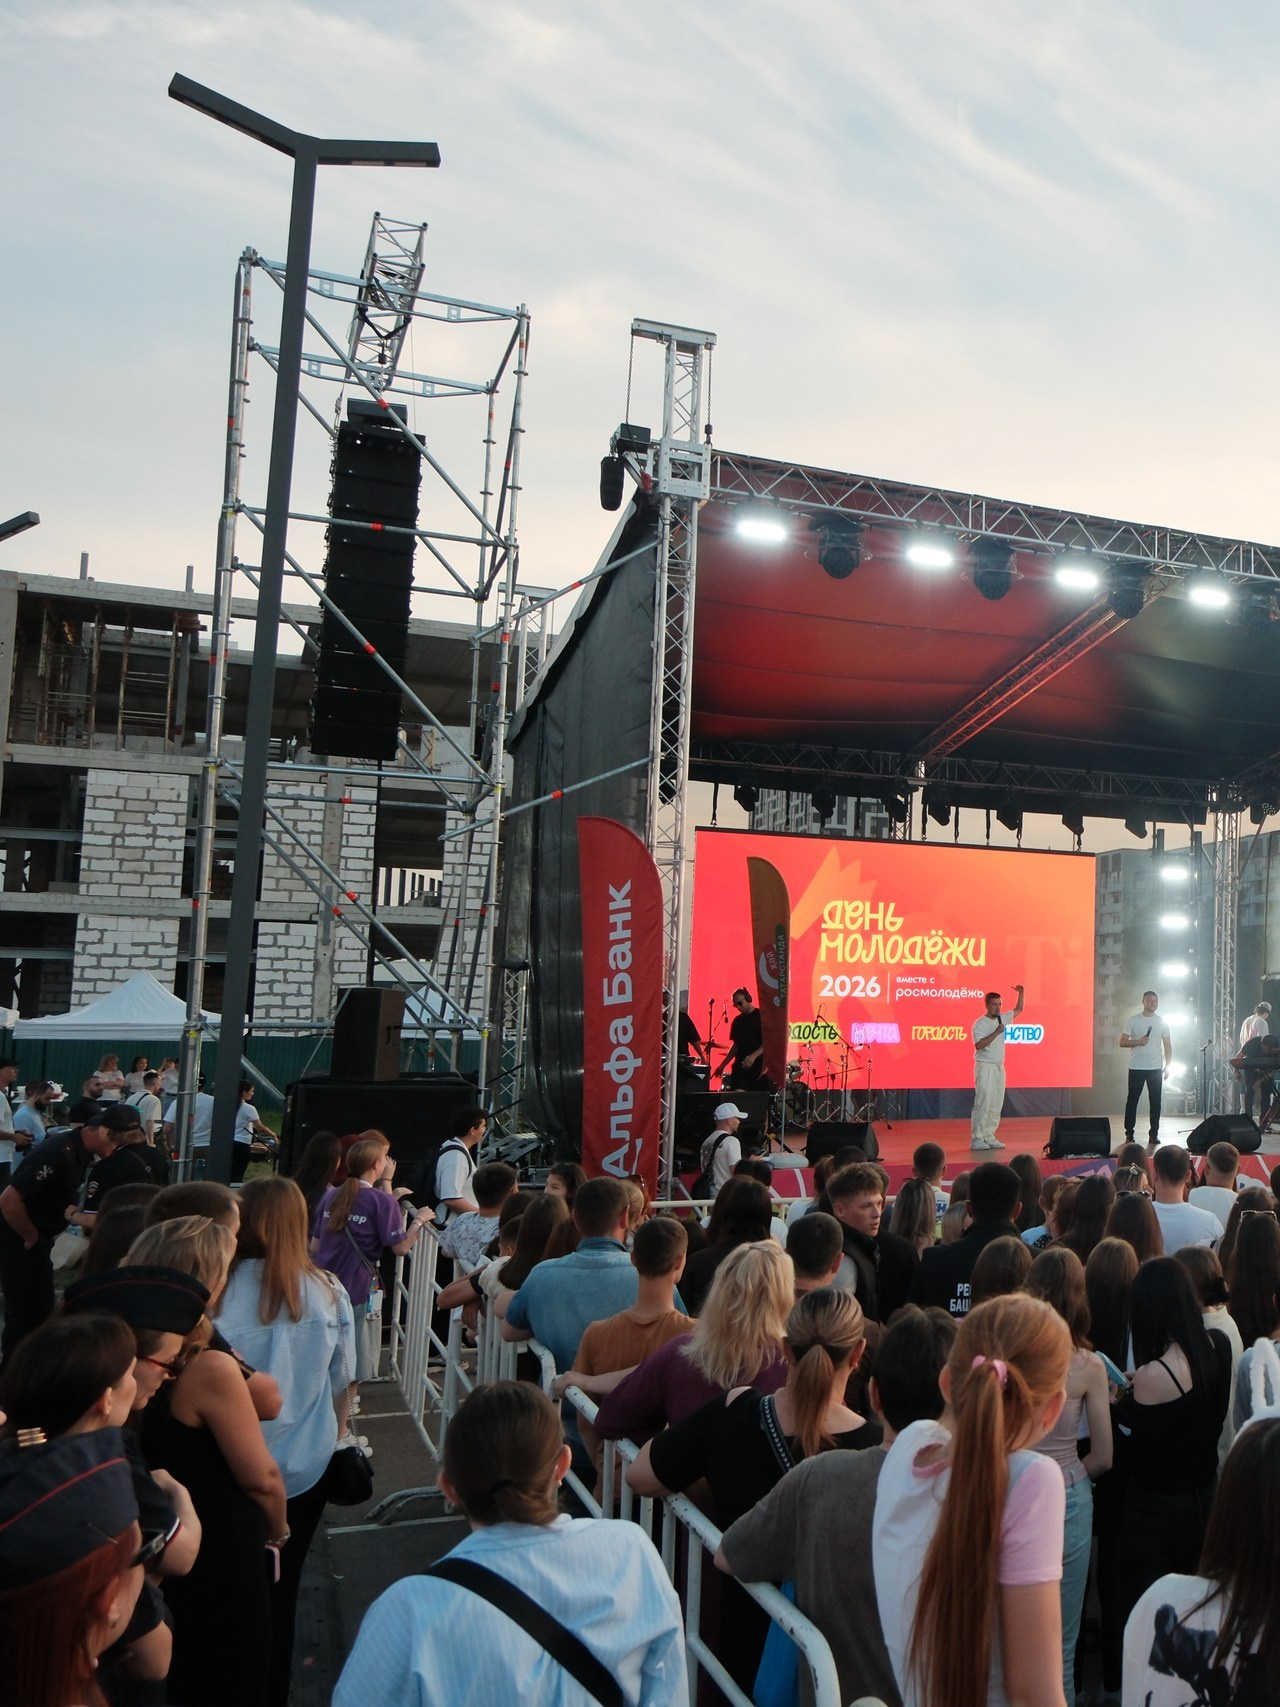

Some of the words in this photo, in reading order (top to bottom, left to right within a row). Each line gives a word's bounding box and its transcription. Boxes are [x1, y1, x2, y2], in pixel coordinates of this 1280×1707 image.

[603, 879, 633, 1006] Банк
[777, 934, 787, 998] ТАТАРСТАНДА
[819, 975, 881, 998] 2026
[896, 975, 927, 984] вместе
[896, 986, 985, 1001] росмолодёжь
[788, 1024, 838, 1040] ДОСТЬ
[912, 1025, 968, 1041] ГОРДОСТЬ
[1003, 1026, 1042, 1041] НСТВО
[602, 1015, 642, 1177] Альфа
[956, 1283, 972, 1297] РЕ
